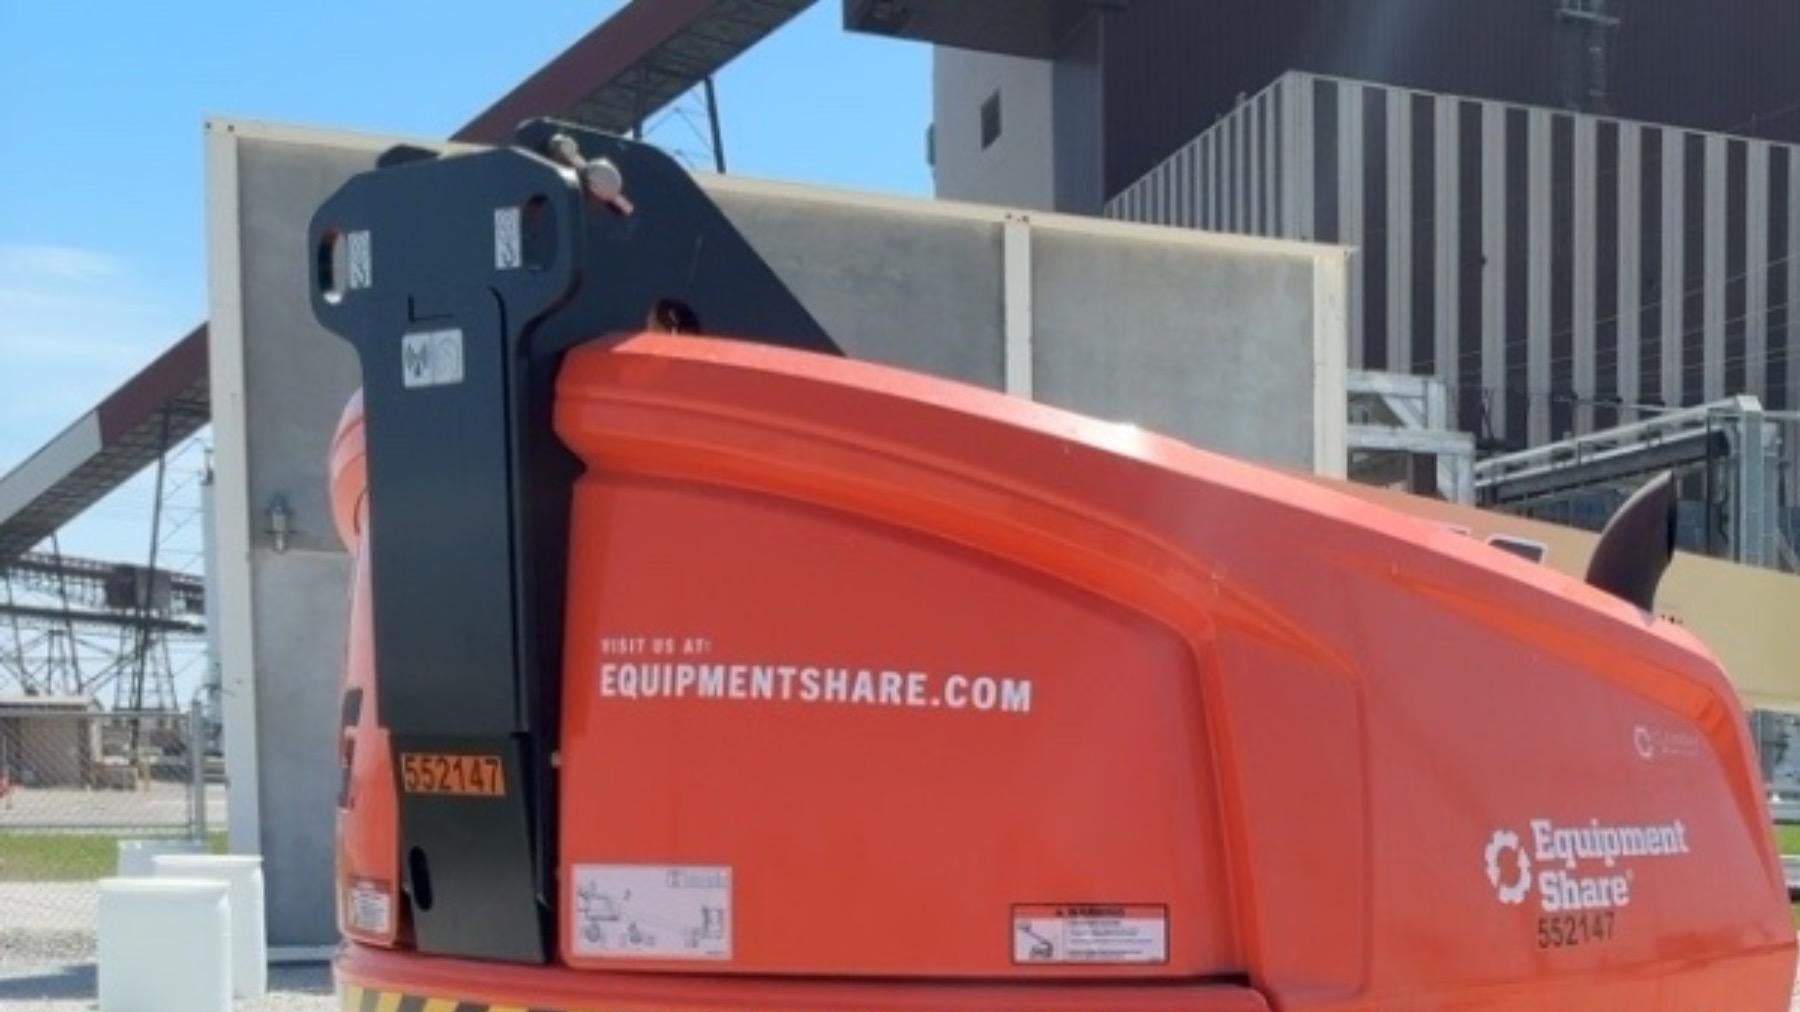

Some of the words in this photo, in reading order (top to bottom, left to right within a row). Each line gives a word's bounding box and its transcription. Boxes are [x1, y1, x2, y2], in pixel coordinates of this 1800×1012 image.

[601, 638, 646, 654] VISIT
[652, 639, 674, 654] US
[599, 663, 1032, 712] EQUIPMENTSHARE.COM
[403, 756, 500, 792] 552147
[1530, 818, 1690, 869] Equipment
[1538, 868, 1630, 912] Share
[1537, 911, 1616, 948] 552147
